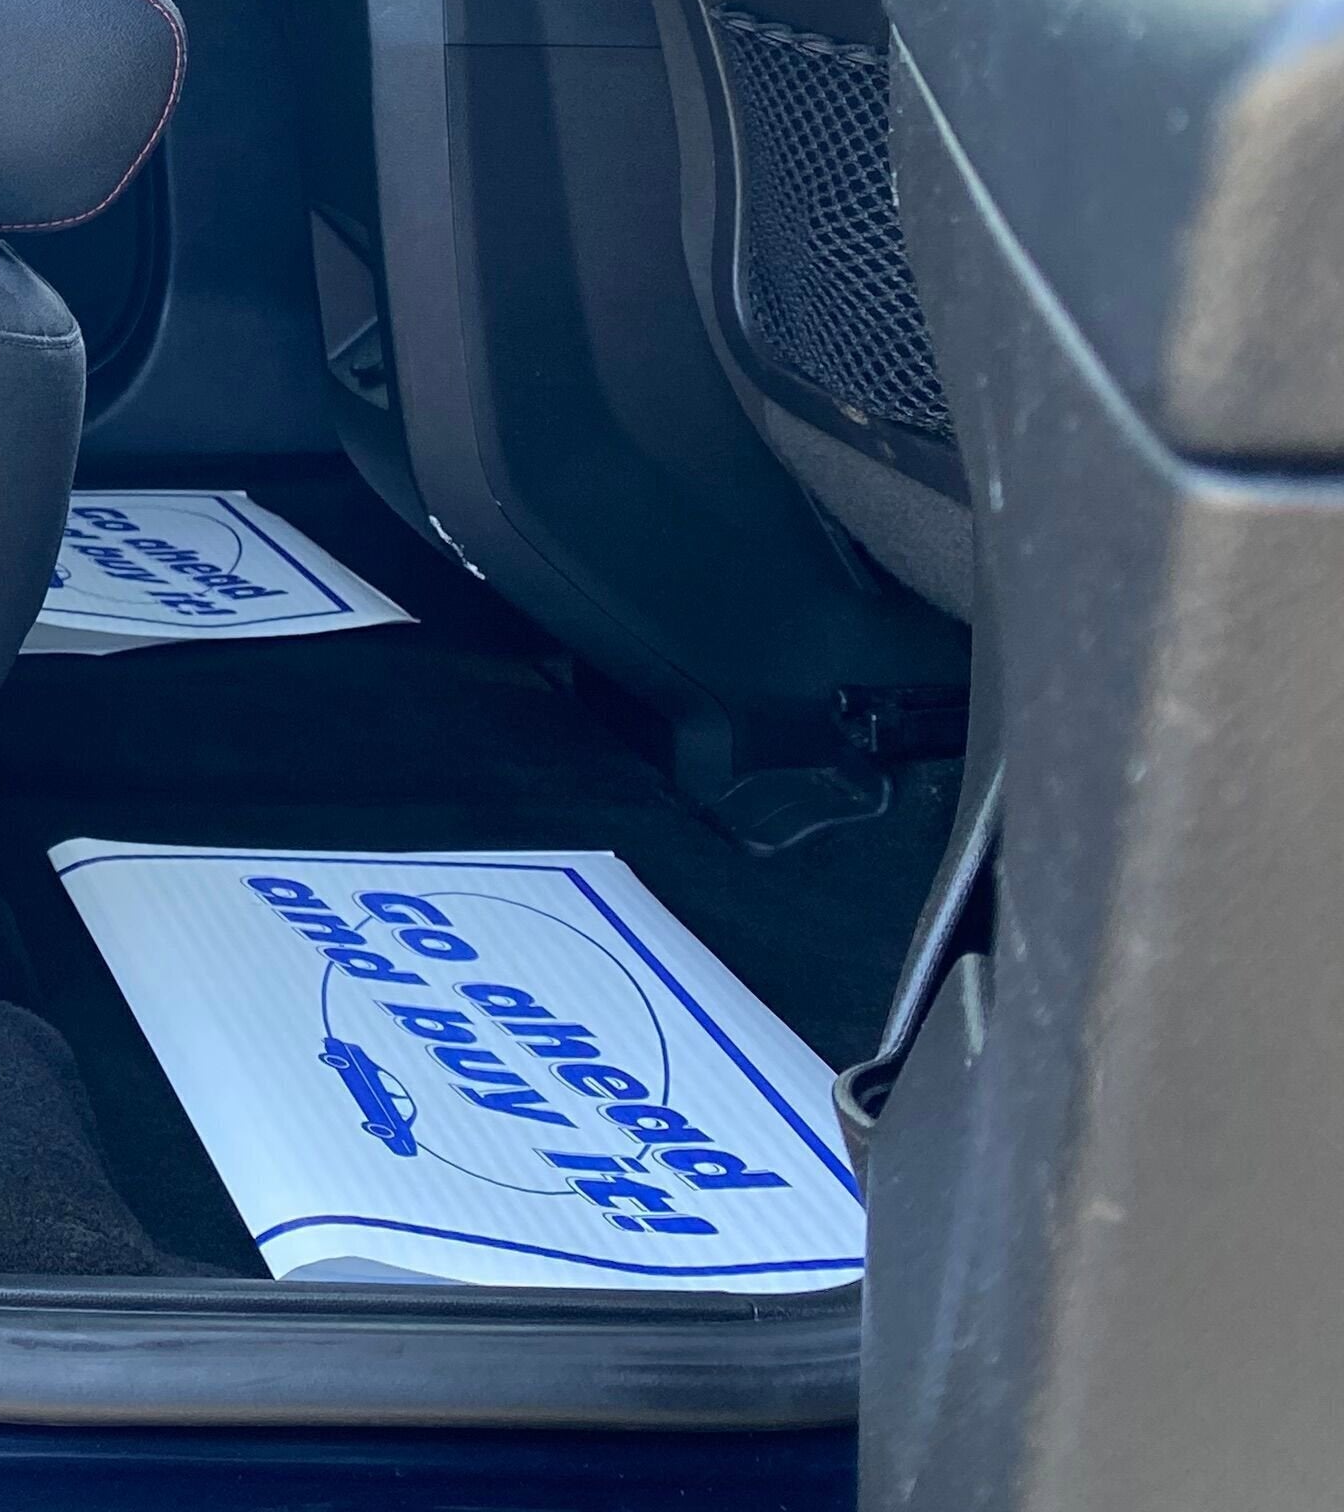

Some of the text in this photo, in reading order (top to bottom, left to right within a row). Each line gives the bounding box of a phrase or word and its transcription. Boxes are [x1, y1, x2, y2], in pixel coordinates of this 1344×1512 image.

[68, 544, 171, 584] buy
[71, 507, 289, 600] Go ahead
[241, 874, 720, 1236] and buy it!
[355, 890, 791, 1189] Go ahead
